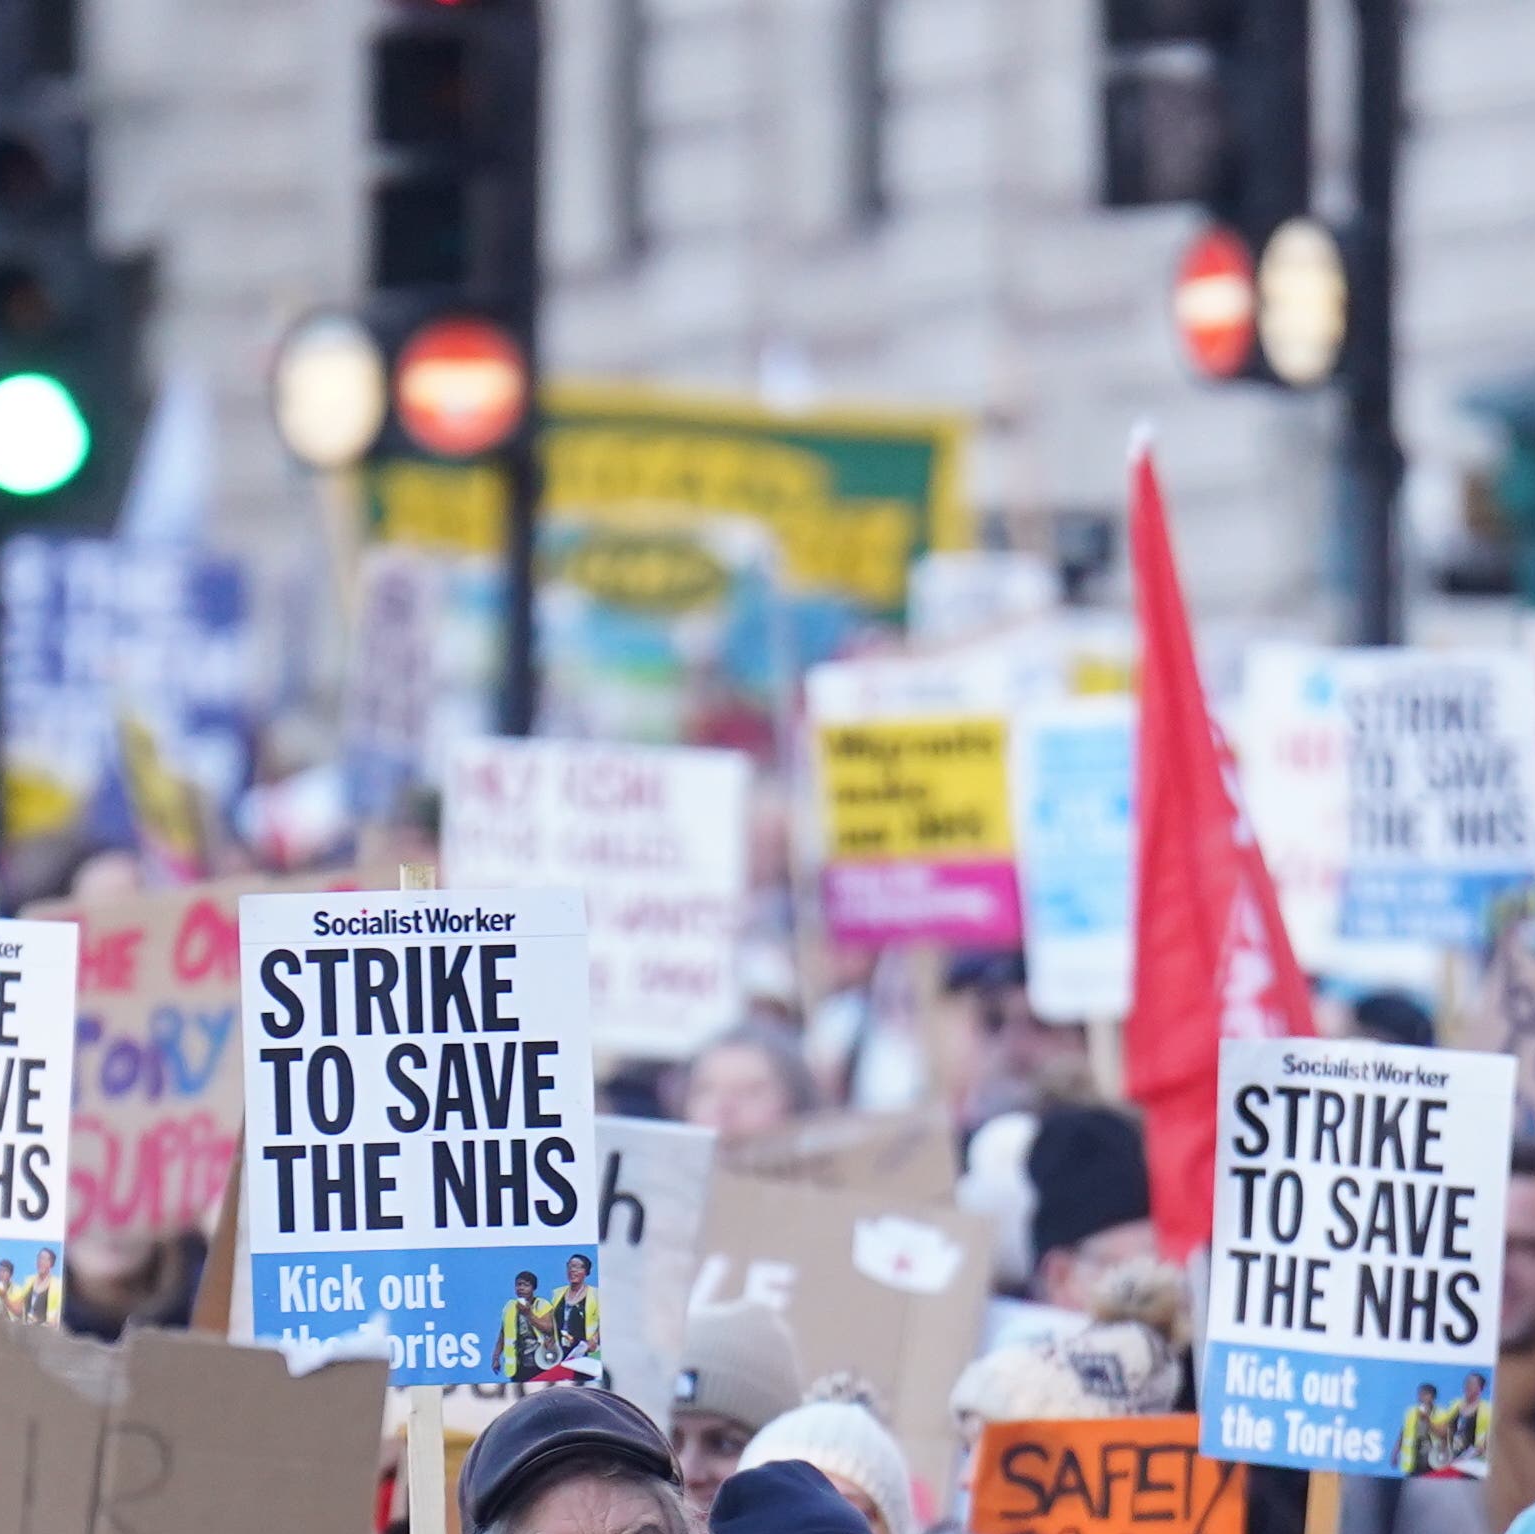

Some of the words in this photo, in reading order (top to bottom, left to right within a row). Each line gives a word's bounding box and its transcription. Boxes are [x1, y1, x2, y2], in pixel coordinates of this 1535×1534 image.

[314, 908, 423, 936] Socialist
[425, 907, 516, 935] Worker
[260, 943, 521, 1040] STRIKE
[260, 1044, 355, 1137] TO
[385, 1040, 563, 1134] SAVE
[1282, 1052, 1368, 1082] Socialist
[1371, 1060, 1450, 1090] Worker
[1231, 1084, 1448, 1175] STRIKE
[262, 1142, 405, 1234] THE
[432, 1136, 579, 1229] NHS
[1229, 1166, 1304, 1244] TO
[1325, 1175, 1475, 1261] SAVE
[279, 1264, 366, 1313] Kick
[379, 1263, 445, 1311] out
[1227, 1251, 1331, 1333] THE
[1353, 1261, 1481, 1347] NHS
[388, 1321, 482, 1371] ories
[1224, 1352, 1296, 1402] Kick
[1303, 1366, 1357, 1411] out
[1220, 1408, 1274, 1452] the
[1286, 1413, 1384, 1463] Tories
